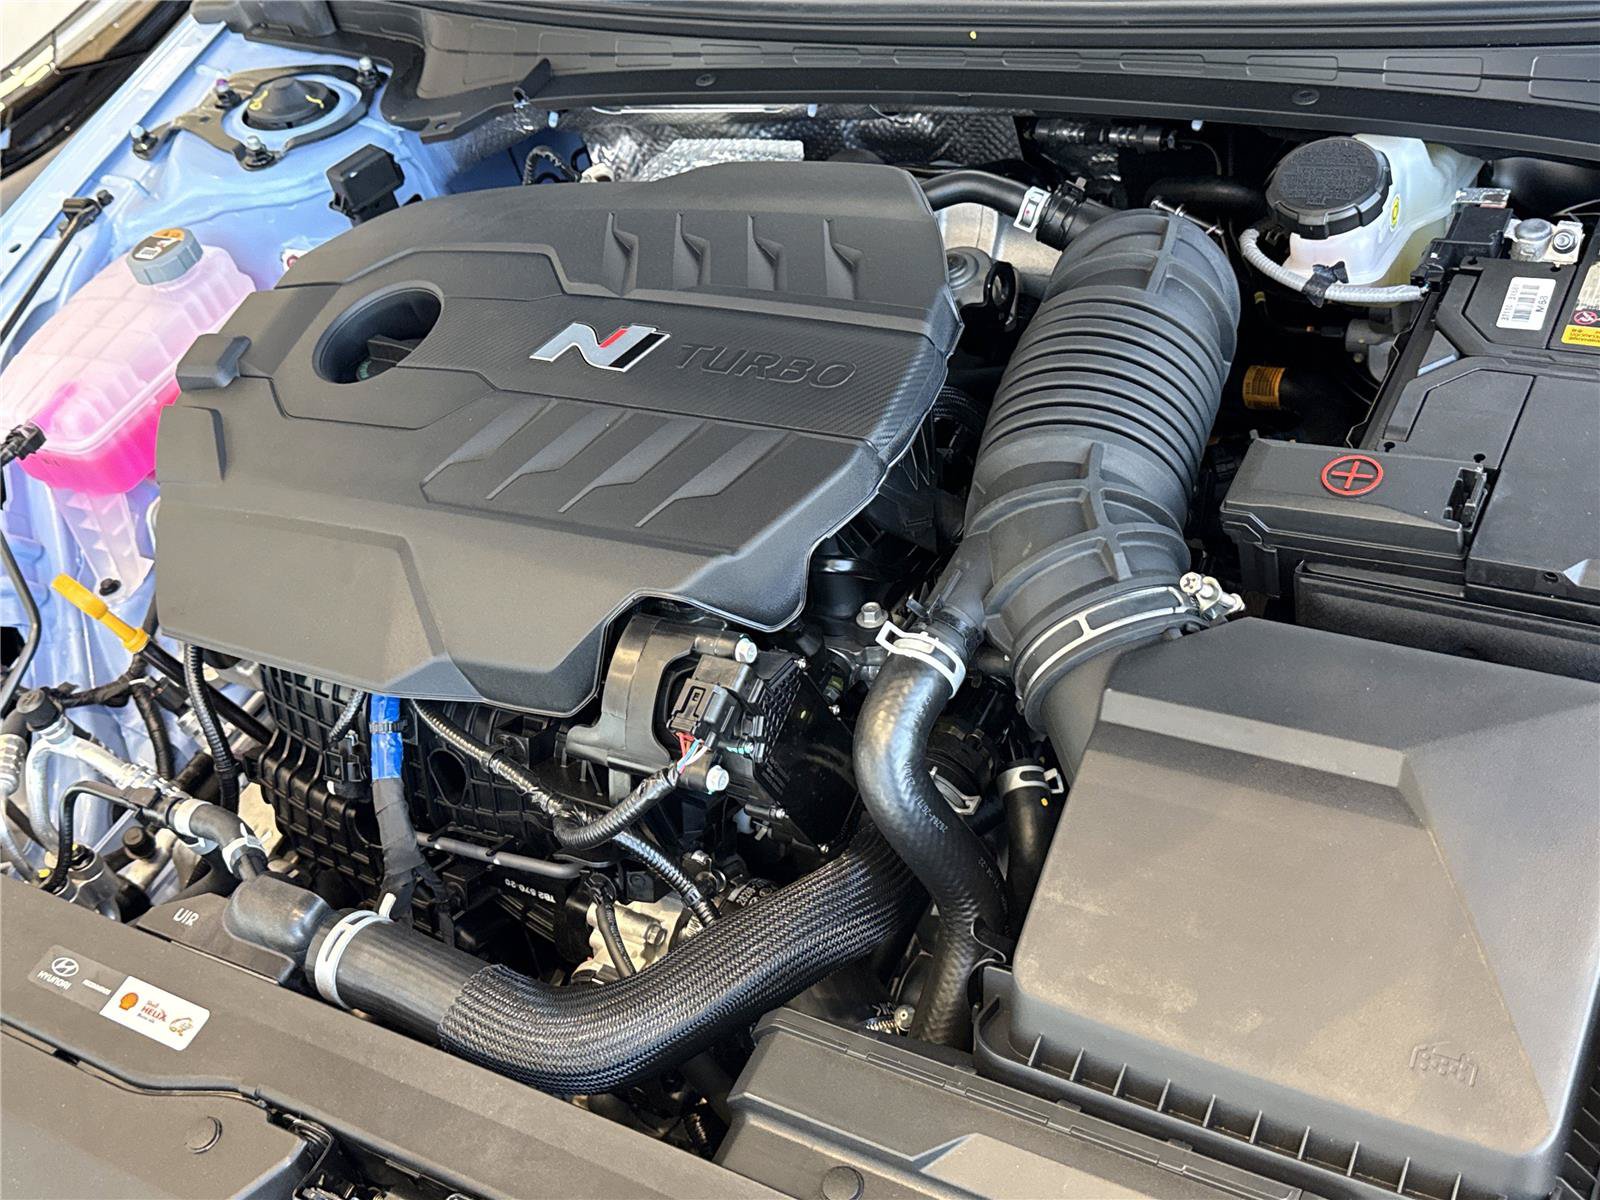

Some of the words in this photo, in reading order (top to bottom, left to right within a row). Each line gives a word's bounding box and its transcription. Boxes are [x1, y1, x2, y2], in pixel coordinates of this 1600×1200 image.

[675, 343, 856, 389] TURBO
[36, 970, 73, 991] HYUNDAI
[141, 1004, 168, 1022] HELIX
